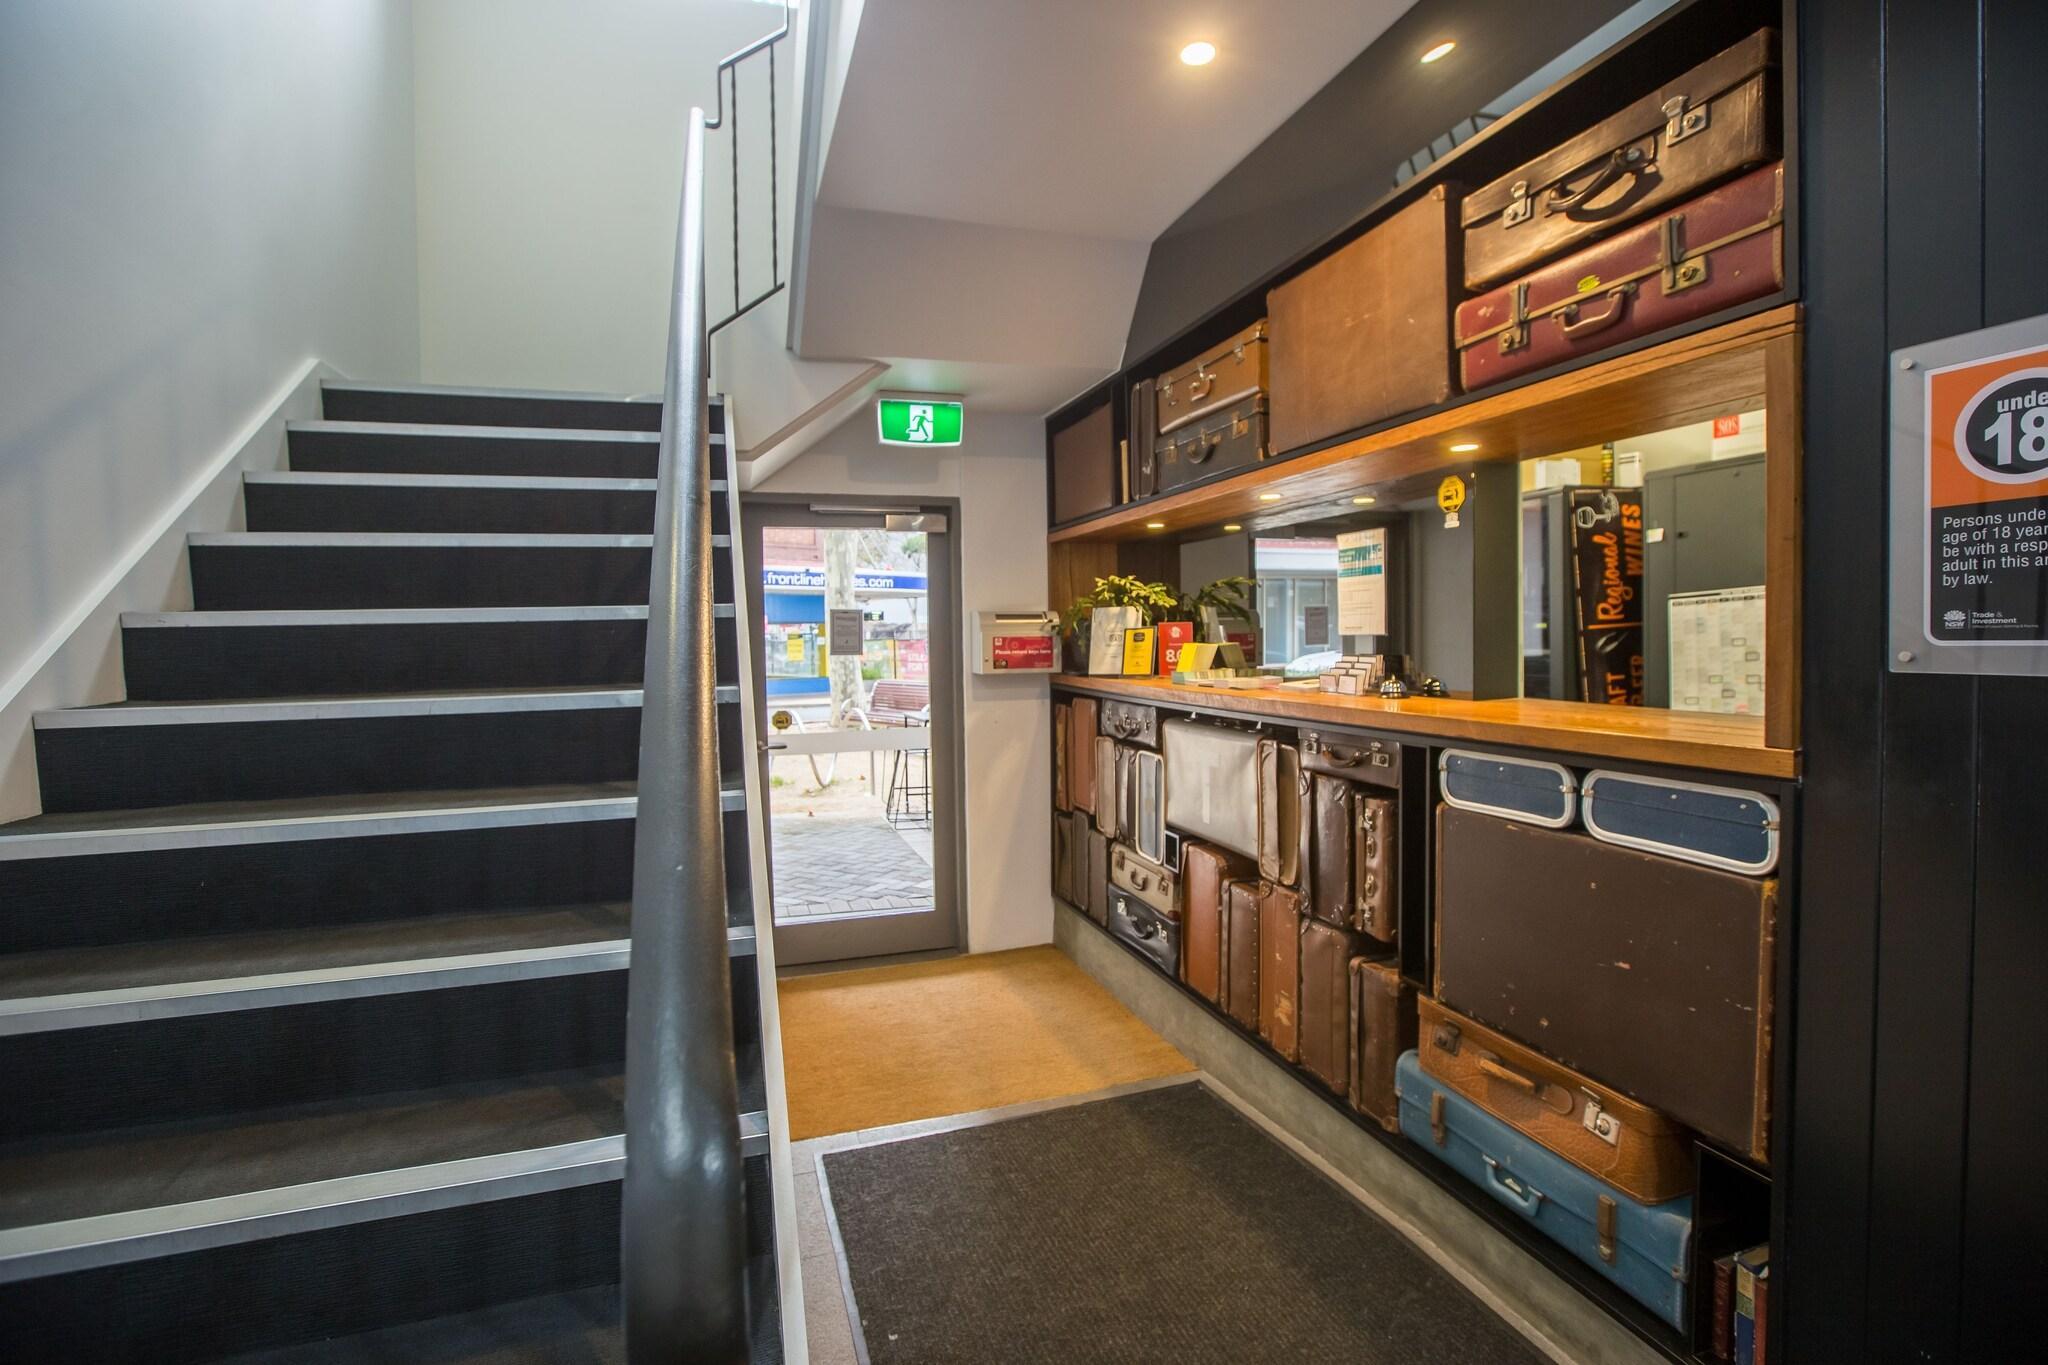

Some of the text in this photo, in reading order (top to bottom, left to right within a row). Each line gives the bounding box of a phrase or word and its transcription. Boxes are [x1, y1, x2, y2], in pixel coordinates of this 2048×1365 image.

[1997, 390, 2048, 413] unde
[1984, 406, 2048, 466] 18
[1943, 508, 2047, 528] Persons unde
[1621, 503, 1643, 576] WINES
[1942, 531, 1968, 545] age
[1972, 527, 1988, 541] of
[1992, 526, 2011, 539] 18
[1943, 540, 2048, 558] be with a resp
[1942, 559, 1978, 572] adult
[1983, 557, 1996, 569] in
[2001, 555, 2030, 568] this
[764, 571, 893, 588] .frontlinehes.com
[1592, 531, 1633, 620] Regional
[1943, 573, 1993, 588] by law.
[1606, 671, 1627, 705] AFT
